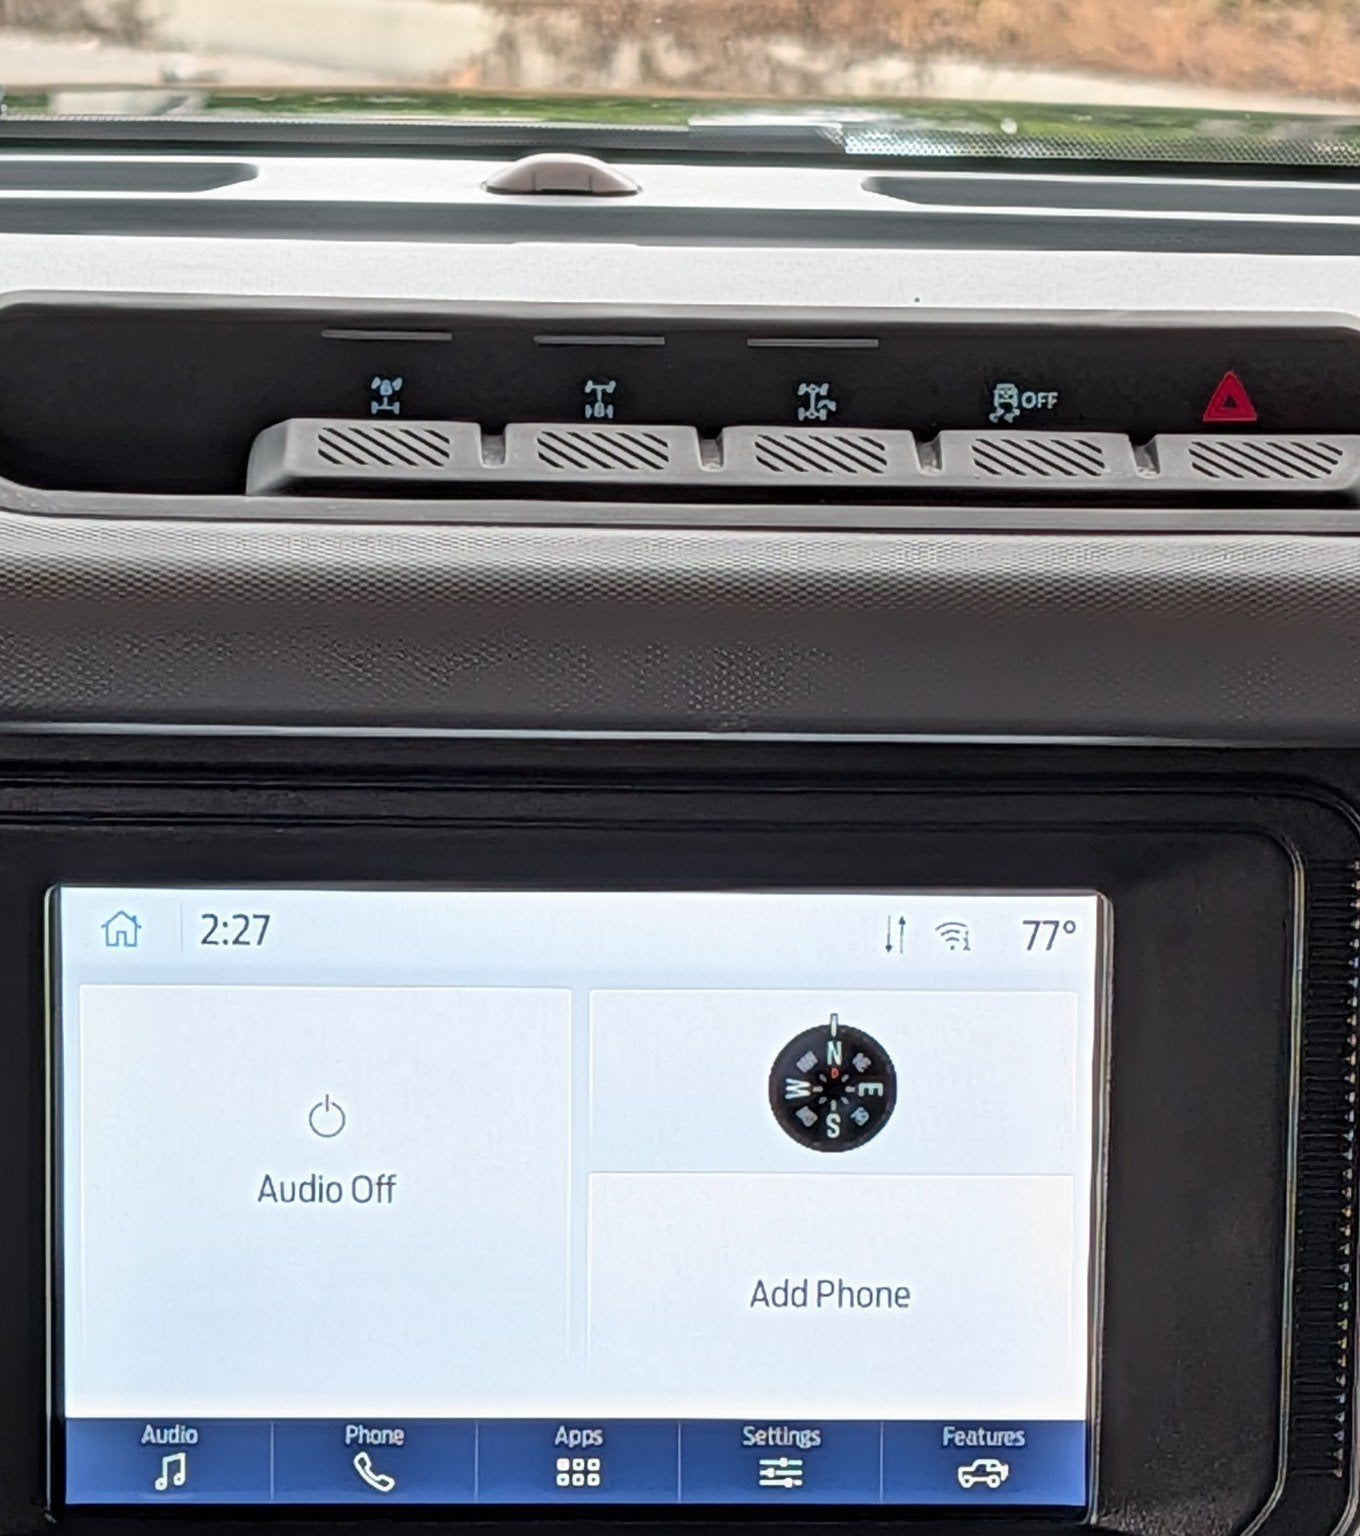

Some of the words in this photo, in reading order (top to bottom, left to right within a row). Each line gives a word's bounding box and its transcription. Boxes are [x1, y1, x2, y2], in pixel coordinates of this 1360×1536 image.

[1021, 391, 1058, 409] OFF
[201, 913, 271, 946] 2:27
[1022, 919, 1076, 951] 77°
[827, 1041, 842, 1066] N
[785, 1078, 811, 1100] W
[858, 1082, 884, 1097] E
[826, 1113, 841, 1139] S
[258, 1173, 343, 1203] Audio
[352, 1173, 397, 1203] Off
[750, 1278, 808, 1308] Add
[817, 1278, 911, 1308] Phone
[141, 1424, 198, 1444] Audio
[345, 1424, 405, 1445] Phone
[555, 1425, 603, 1448] Apps
[742, 1425, 821, 1449] Settings
[942, 1426, 1026, 1446] Features
